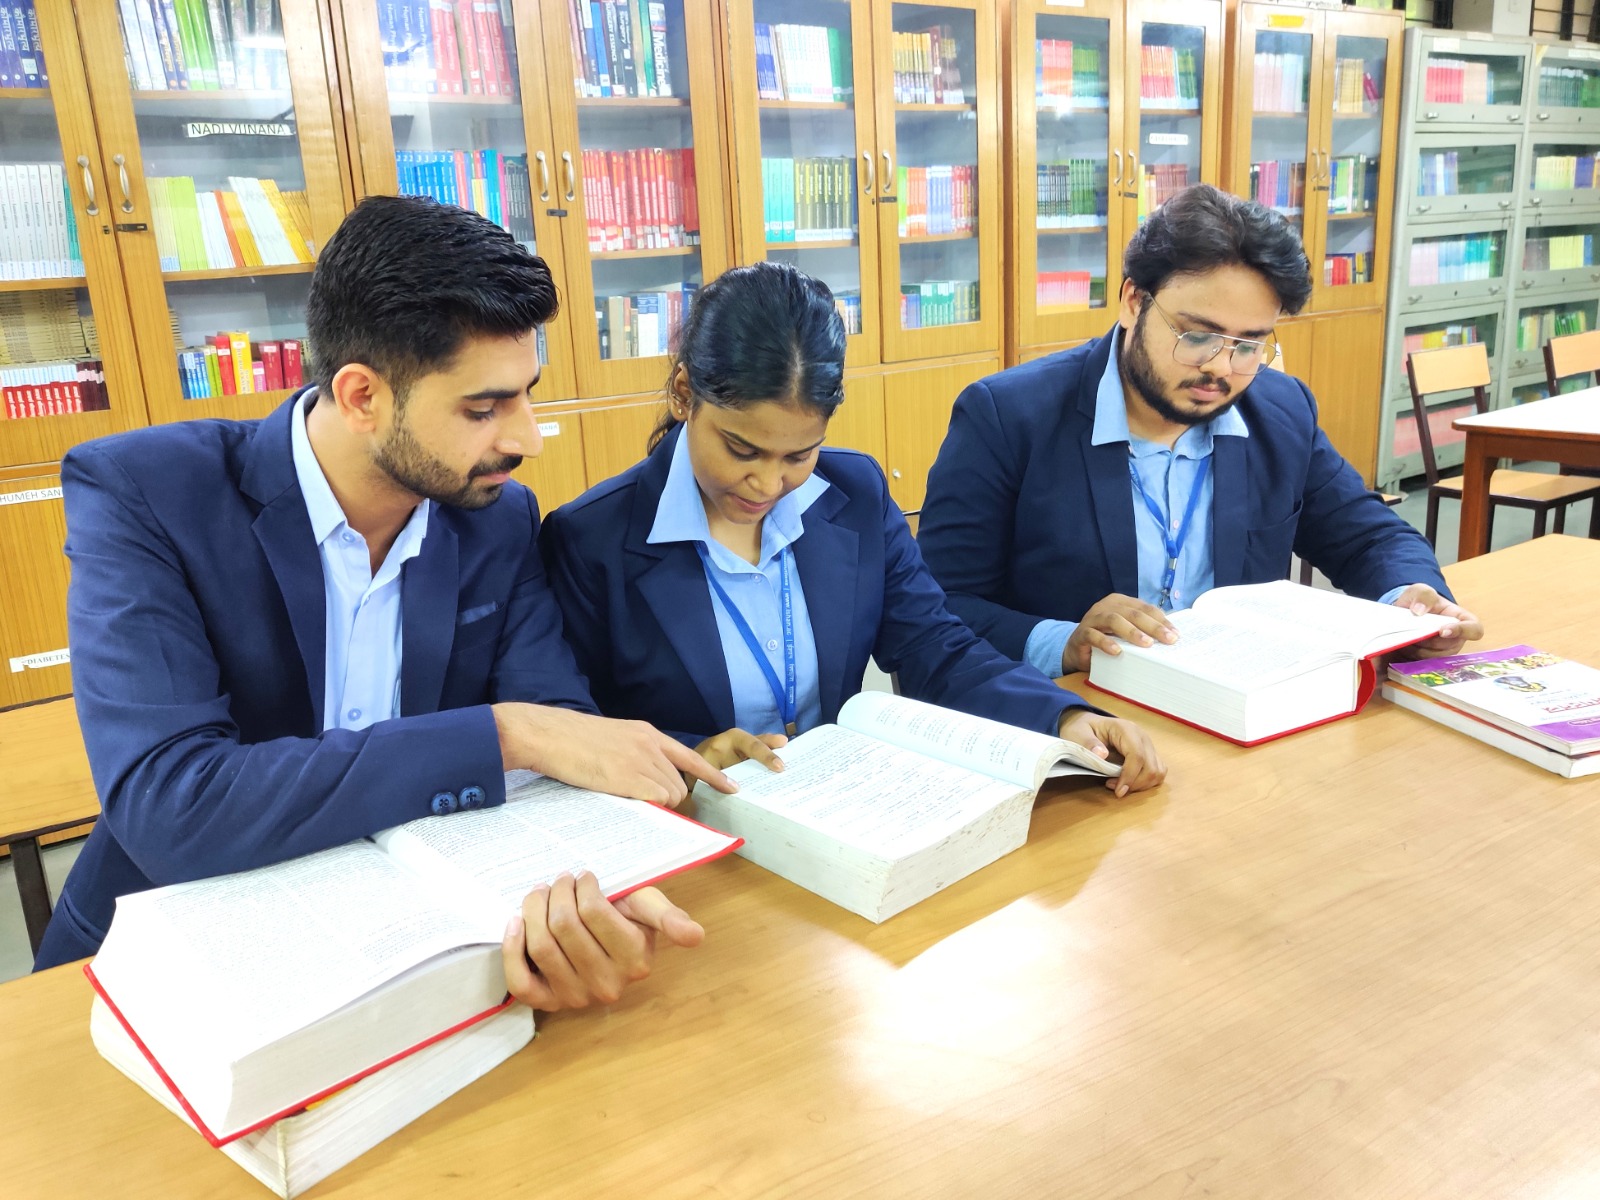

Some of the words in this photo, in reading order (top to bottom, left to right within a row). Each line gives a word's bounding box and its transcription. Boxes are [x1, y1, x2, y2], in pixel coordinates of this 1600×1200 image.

[653, 36, 667, 85] Medicine
[191, 123, 225, 134] NADI
[41, 489, 61, 498] SAN
